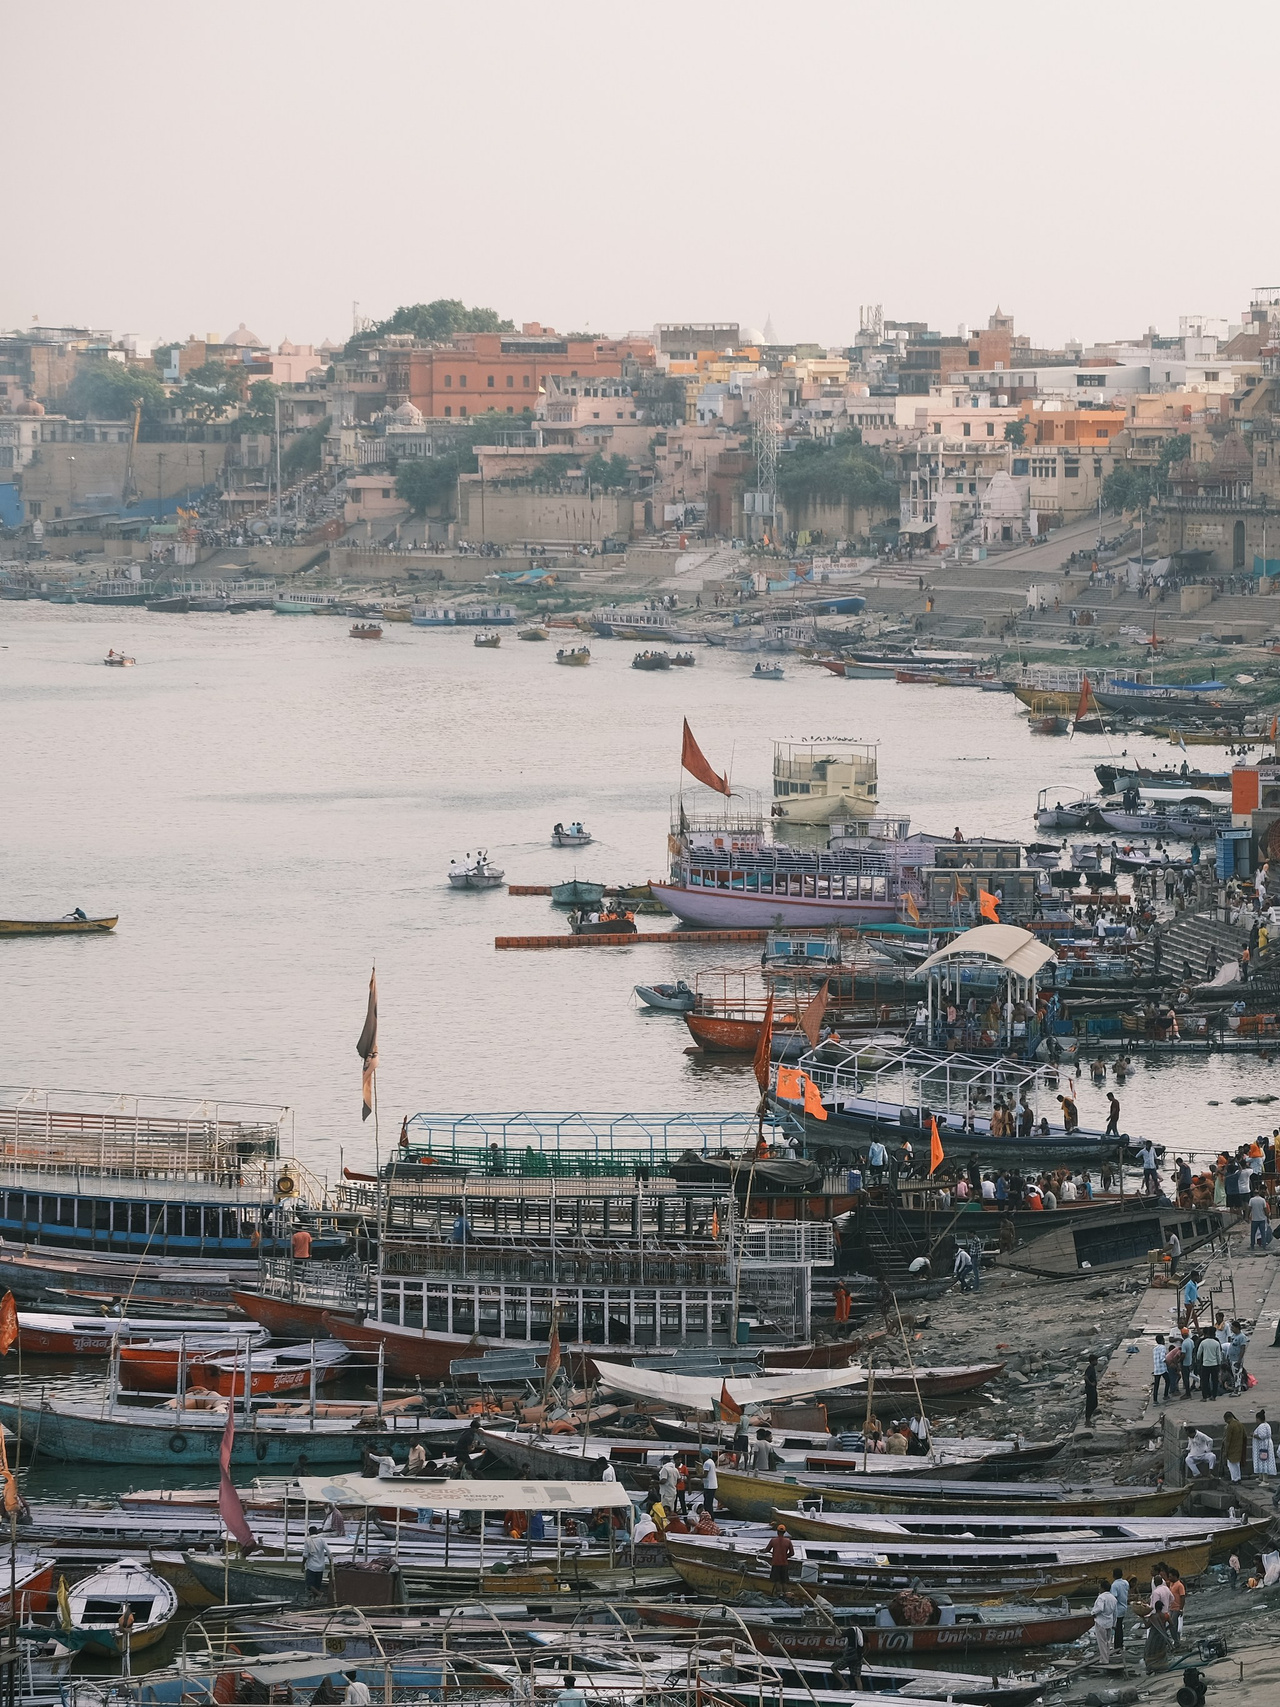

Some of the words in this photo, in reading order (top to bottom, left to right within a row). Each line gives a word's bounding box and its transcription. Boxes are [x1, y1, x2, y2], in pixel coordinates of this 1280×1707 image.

[72, 1336, 109, 1351] यूनियन
[273, 1374, 296, 1388] यूनियन
[768, 1632, 823, 1648] यूनियन
[937, 1630, 982, 1644] Union
[985, 1627, 1025, 1641] Bank
